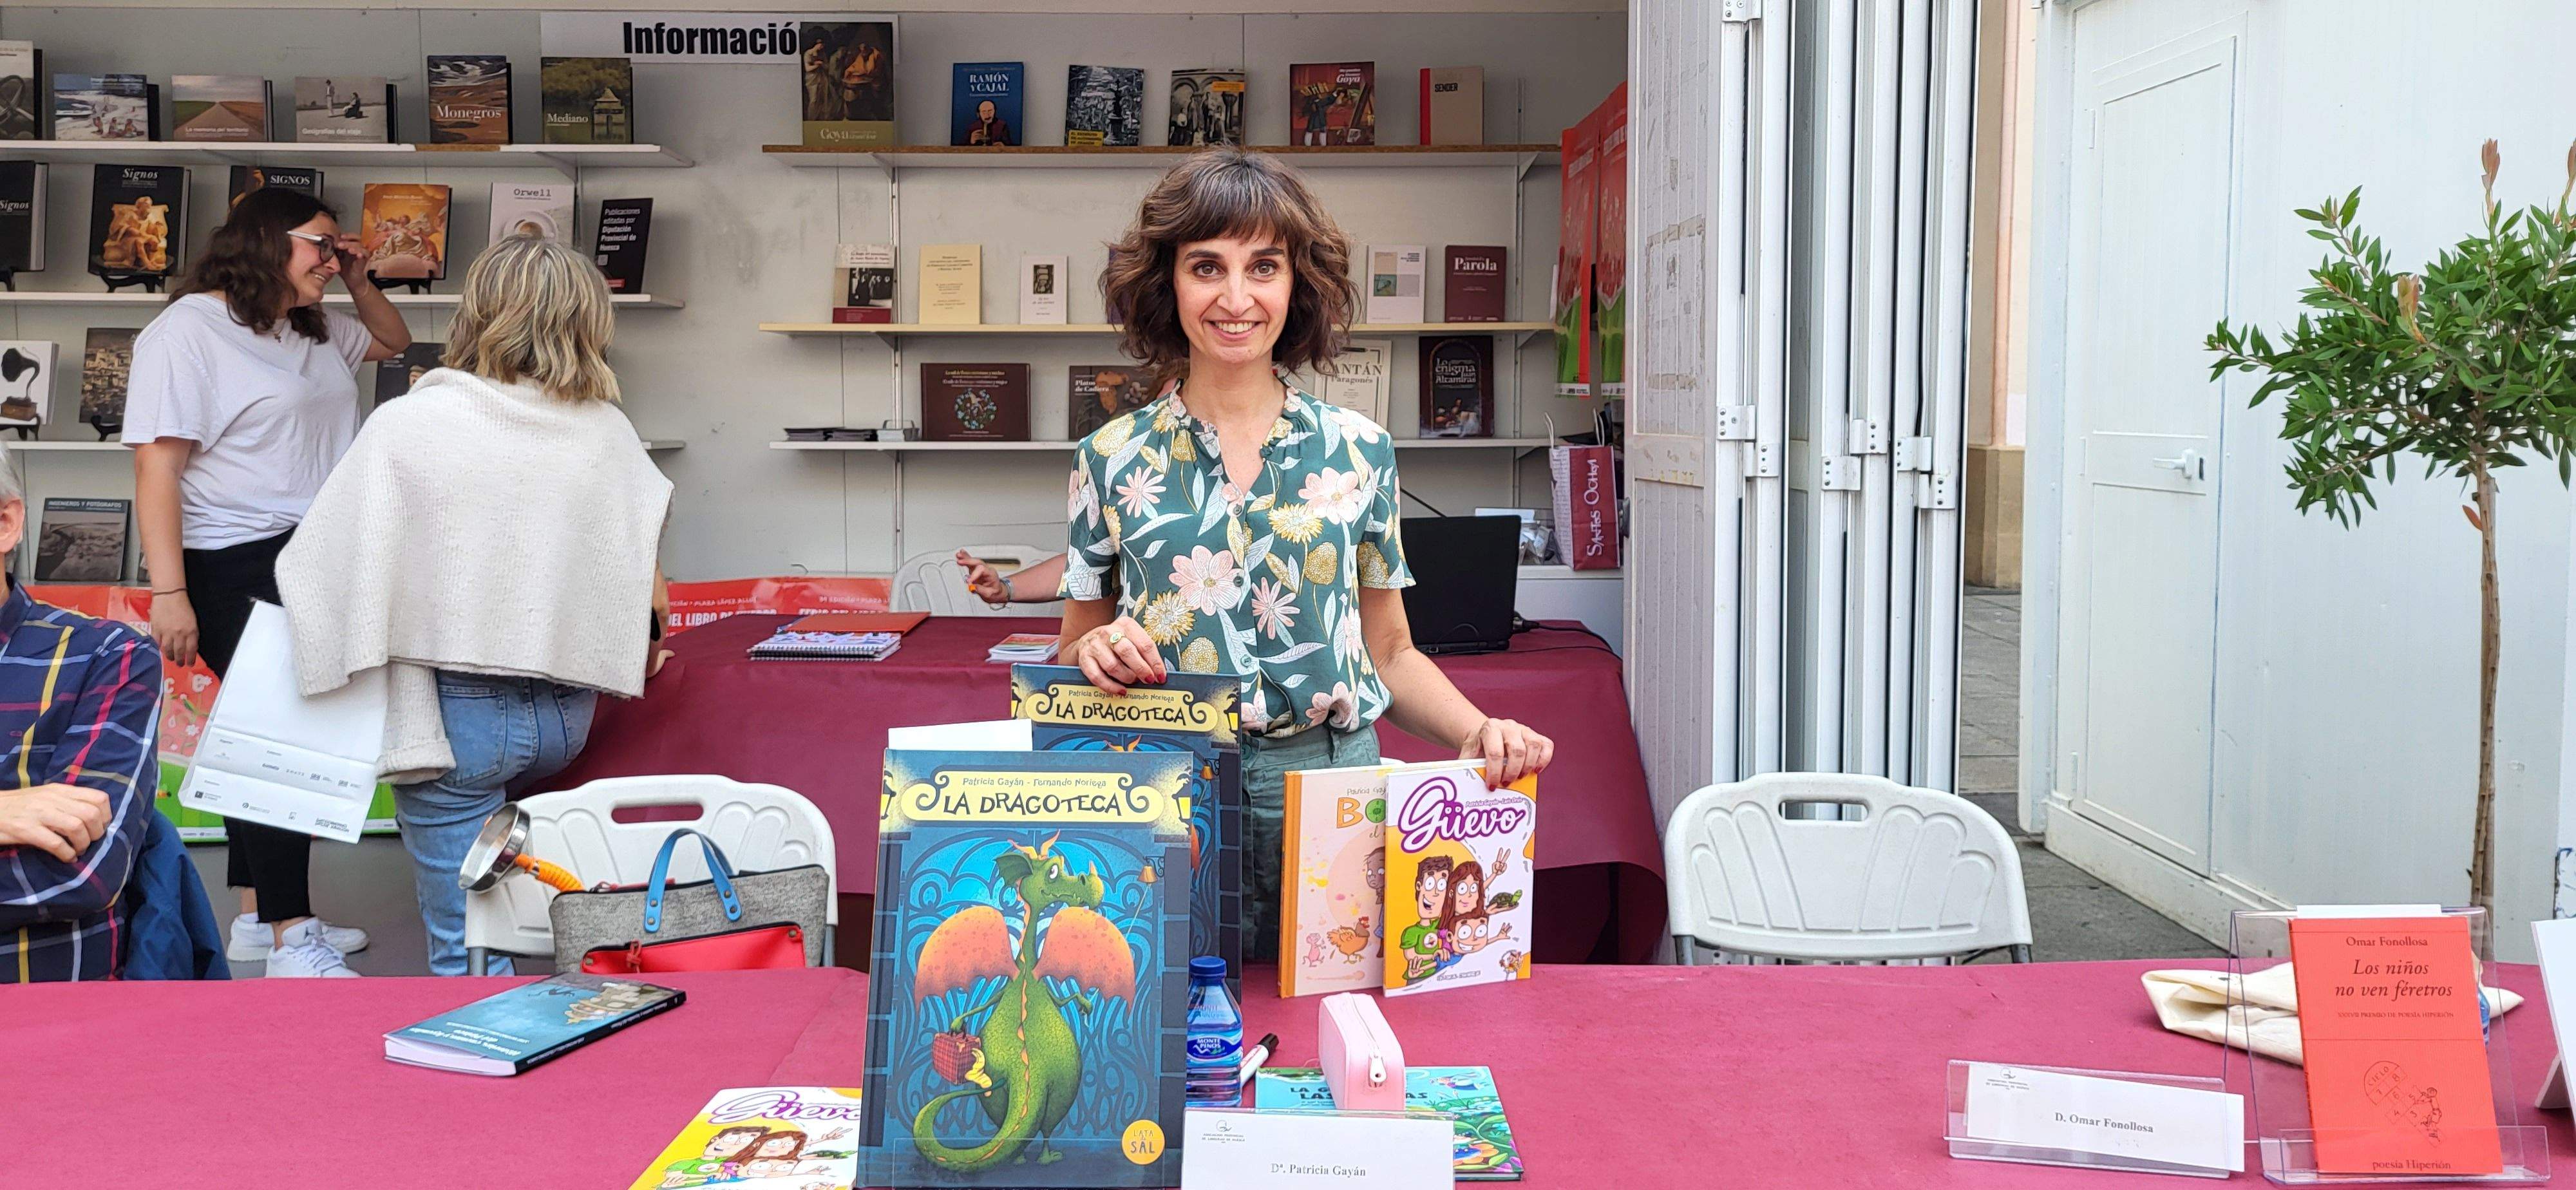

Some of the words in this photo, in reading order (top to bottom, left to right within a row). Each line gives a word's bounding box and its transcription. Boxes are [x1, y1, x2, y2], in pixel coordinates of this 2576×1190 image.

[623, 22, 800, 55] Informació
[970, 72, 1009, 83] RAMÓN
[1336, 74, 1361, 84] Goya
[977, 82, 1009, 92] CAJAL
[1434, 83, 1458, 92] SENDER
[437, 105, 502, 121] Monegros
[547, 113, 589, 123] Mediano
[820, 128, 849, 142] Goya
[122, 167, 159, 182] Signos
[270, 175, 310, 185] SIGNOS
[513, 189, 551, 197] Orwell
[0, 200, 29, 212] Signos
[604, 208, 641, 216] Publicaciones
[625, 217, 636, 226] por
[1454, 258, 1497, 271] Parola
[1435, 364, 1475, 375] enigma
[685, 612, 717, 627] LIBRO
[1150, 695, 1175, 703] Noriega
[1056, 701, 1075, 719] LA
[1082, 703, 1186, 726] DRAGOTECA
[963, 778, 994, 786] Patricia
[998, 777, 1024, 788] Gayán
[1075, 779, 1106, 788] Noriega
[943, 791, 971, 815] LA
[980, 791, 1122, 816] DRAGOTECA
[1398, 777, 1526, 853] Güevo
[2346, 936, 2376, 947] Omar
[2380, 936, 2429, 947] Fonollosa
[2353, 959, 2380, 974] Los
[2386, 959, 2429, 974] niños
[2335, 985, 2354, 996] no
[2361, 985, 2389, 996] ven
[2391, 979, 2452, 1002] féretros
[2055, 1112, 2066, 1122] D.
[2069, 1114, 2101, 1126] Omar
[2104, 1118, 2154, 1133] Fonollosa
[1130, 1141, 1155, 1154] SAL
[1289, 1164, 1329, 1175] Patricia
[1332, 1166, 1366, 1178] Gayán
[2406, 1160, 2451, 1171] Hiperión
